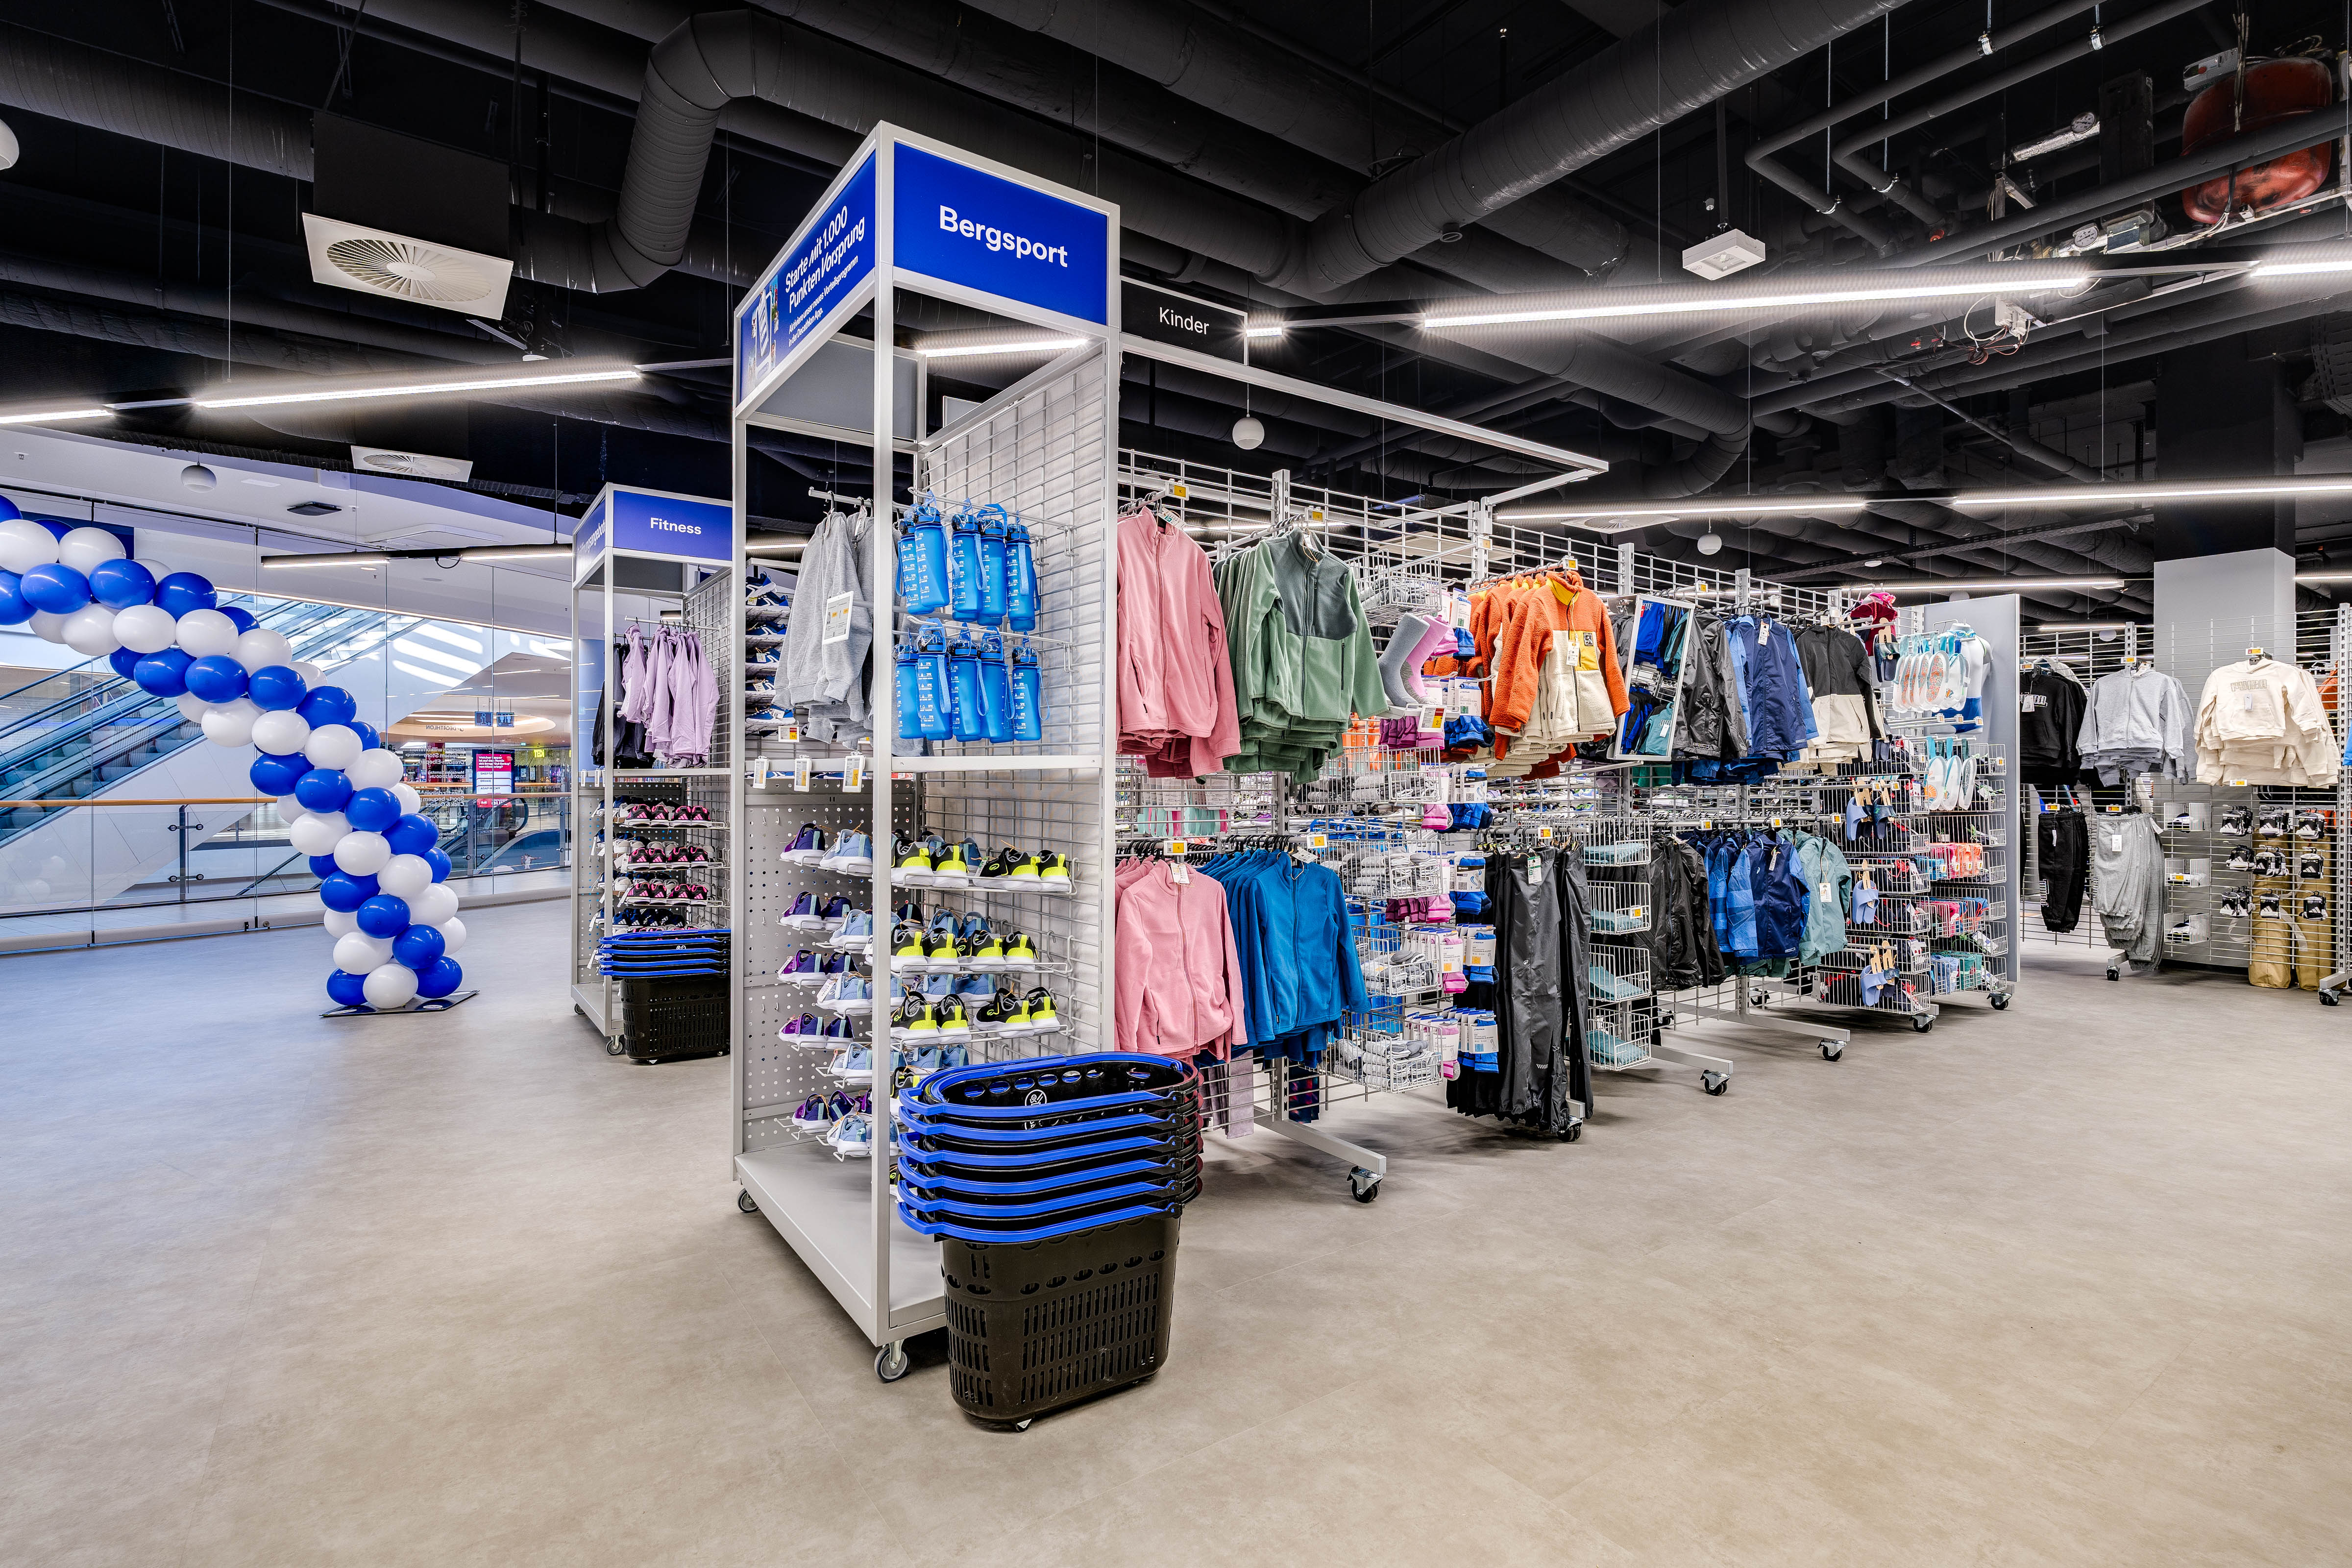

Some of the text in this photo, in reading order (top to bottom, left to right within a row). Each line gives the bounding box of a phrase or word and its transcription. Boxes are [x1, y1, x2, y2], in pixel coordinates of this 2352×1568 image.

[785, 256, 808, 293] Starte
[823, 205, 848, 249] 1.000
[939, 204, 1068, 268] Bergsport
[789, 217, 865, 314] Punkten Vorsprung
[788, 255, 858, 335] Aktiviere unser neues Vorteilsprogramm
[788, 337, 792, 347] in
[797, 317, 814, 339] Decathlon
[814, 307, 824, 323] App.
[1159, 306, 1209, 335] Kinder
[650, 517, 702, 535] Fitness
[2230, 679, 2267, 691] PUMA
[534, 749, 545, 758] TEDi
